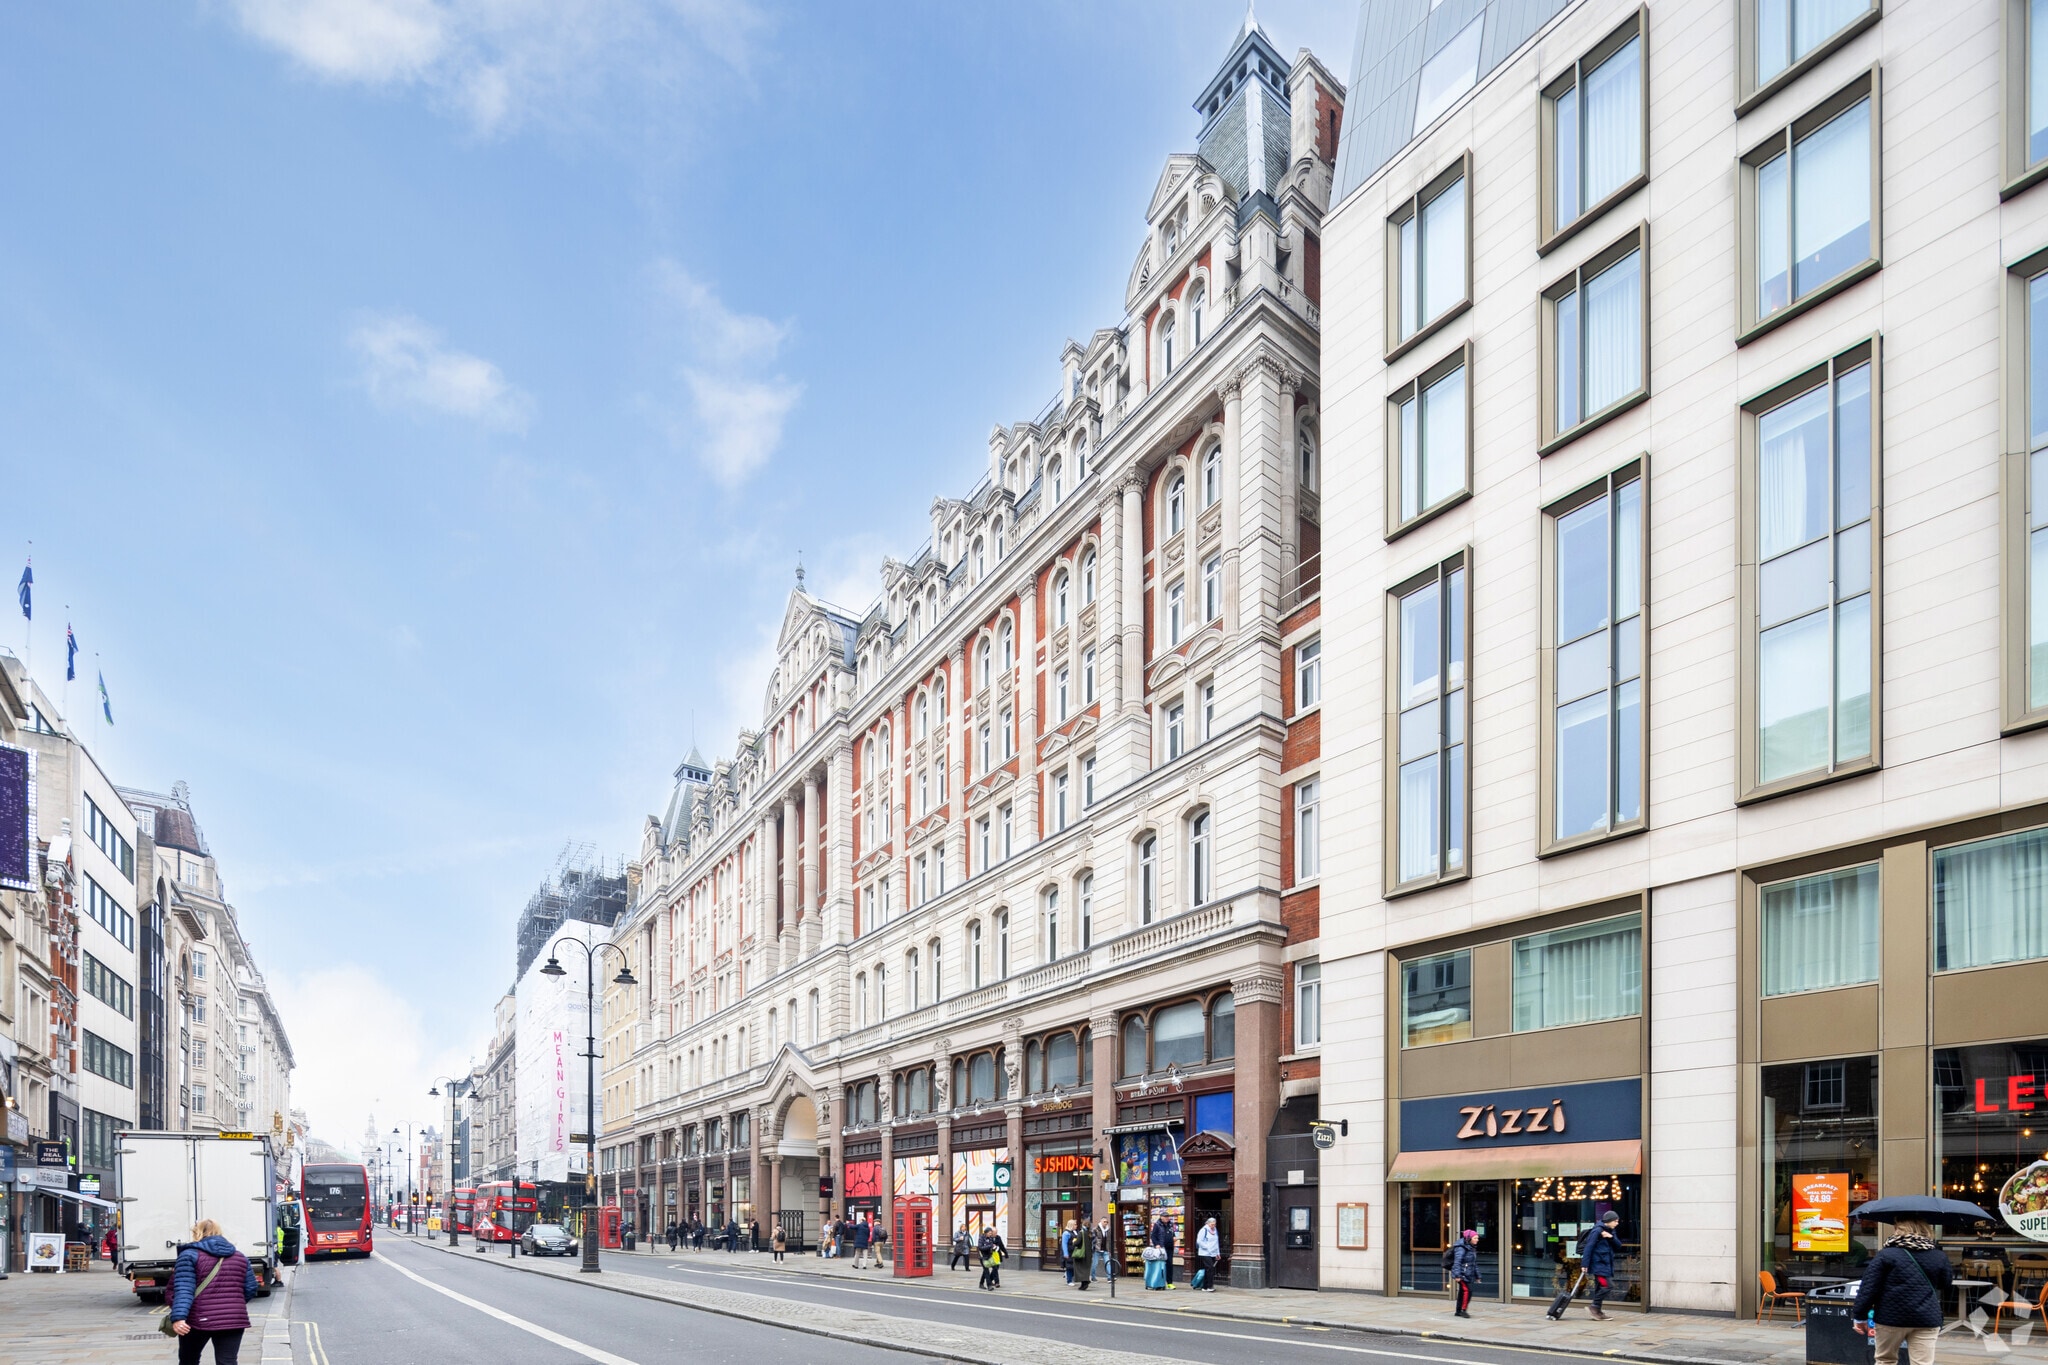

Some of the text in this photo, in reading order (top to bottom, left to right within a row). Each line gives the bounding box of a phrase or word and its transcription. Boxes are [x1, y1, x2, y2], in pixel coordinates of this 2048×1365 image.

[1975, 1074, 2048, 1113] LE
[1042, 1100, 1073, 1112] SUSHIDOG
[1455, 1098, 1566, 1139] Zizzi
[1316, 1132, 1333, 1142] Zizzi
[329, 1187, 341, 1195] 176
[1531, 1174, 1622, 1202] Zizzi
[1802, 1183, 1839, 1193] BREAKFAST
[1809, 1194, 1831, 1203] £4.99
[2020, 1216, 2048, 1231] SUPE
